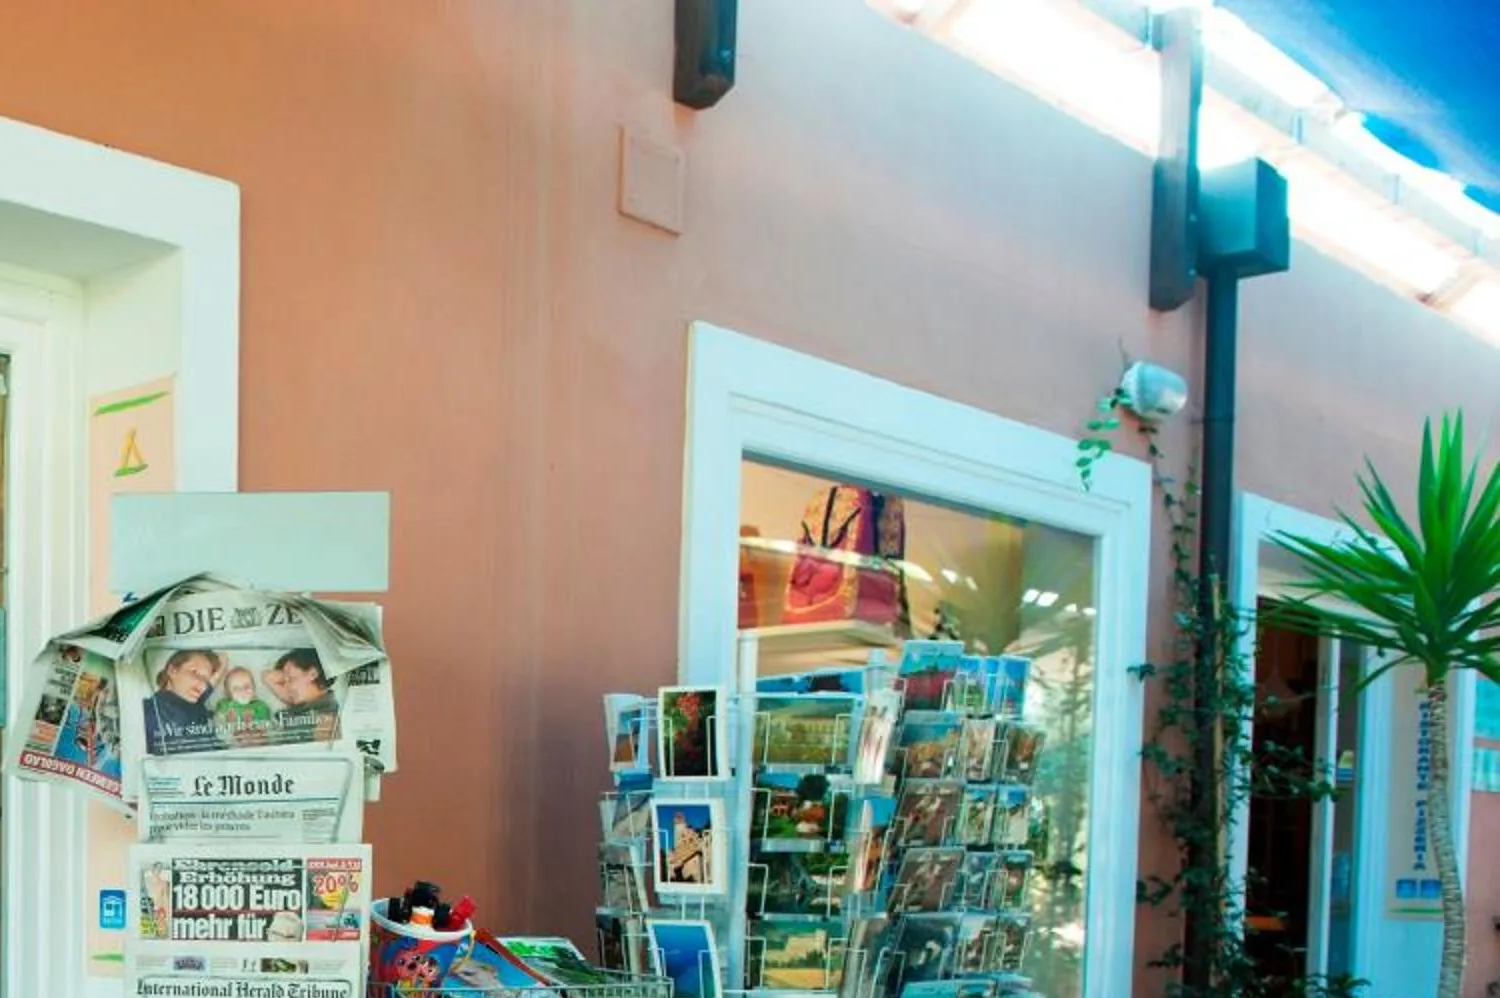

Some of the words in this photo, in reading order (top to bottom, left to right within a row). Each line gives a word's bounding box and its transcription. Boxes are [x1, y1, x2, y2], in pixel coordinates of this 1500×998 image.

[173, 607, 227, 635] DIE
[192, 777, 213, 797] Le
[217, 773, 296, 796] Monde
[179, 872, 297, 887] Erhöhung
[249, 886, 301, 911] Euro
[173, 914, 234, 940] mehr
[238, 913, 267, 940] für
[136, 980, 233, 998] International
[235, 981, 285, 998] Herald
